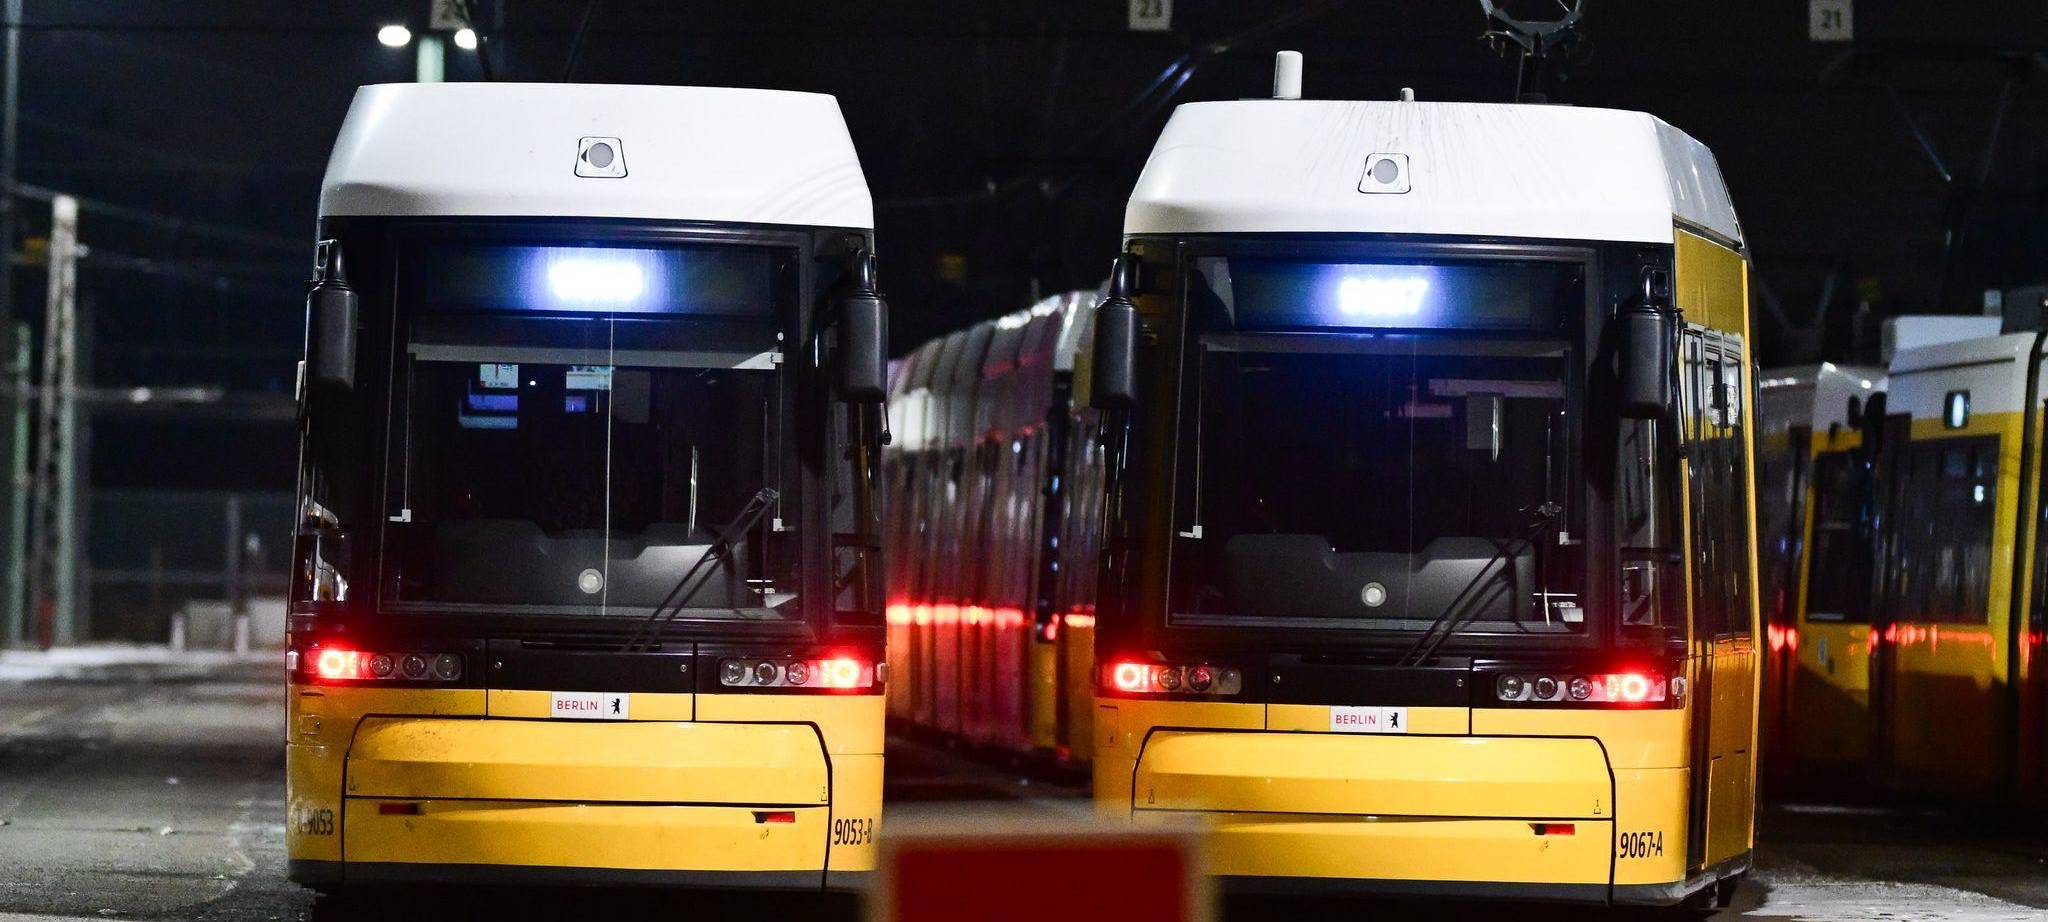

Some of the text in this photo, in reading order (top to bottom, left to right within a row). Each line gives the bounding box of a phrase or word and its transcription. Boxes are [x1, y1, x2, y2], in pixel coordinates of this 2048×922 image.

[1821, 8, 1842, 30] 21
[556, 699, 598, 711] BERLIN
[1335, 714, 1376, 725] BERLIN
[833, 818, 873, 846] 9053-B
[1619, 830, 1663, 859] 9067-A
